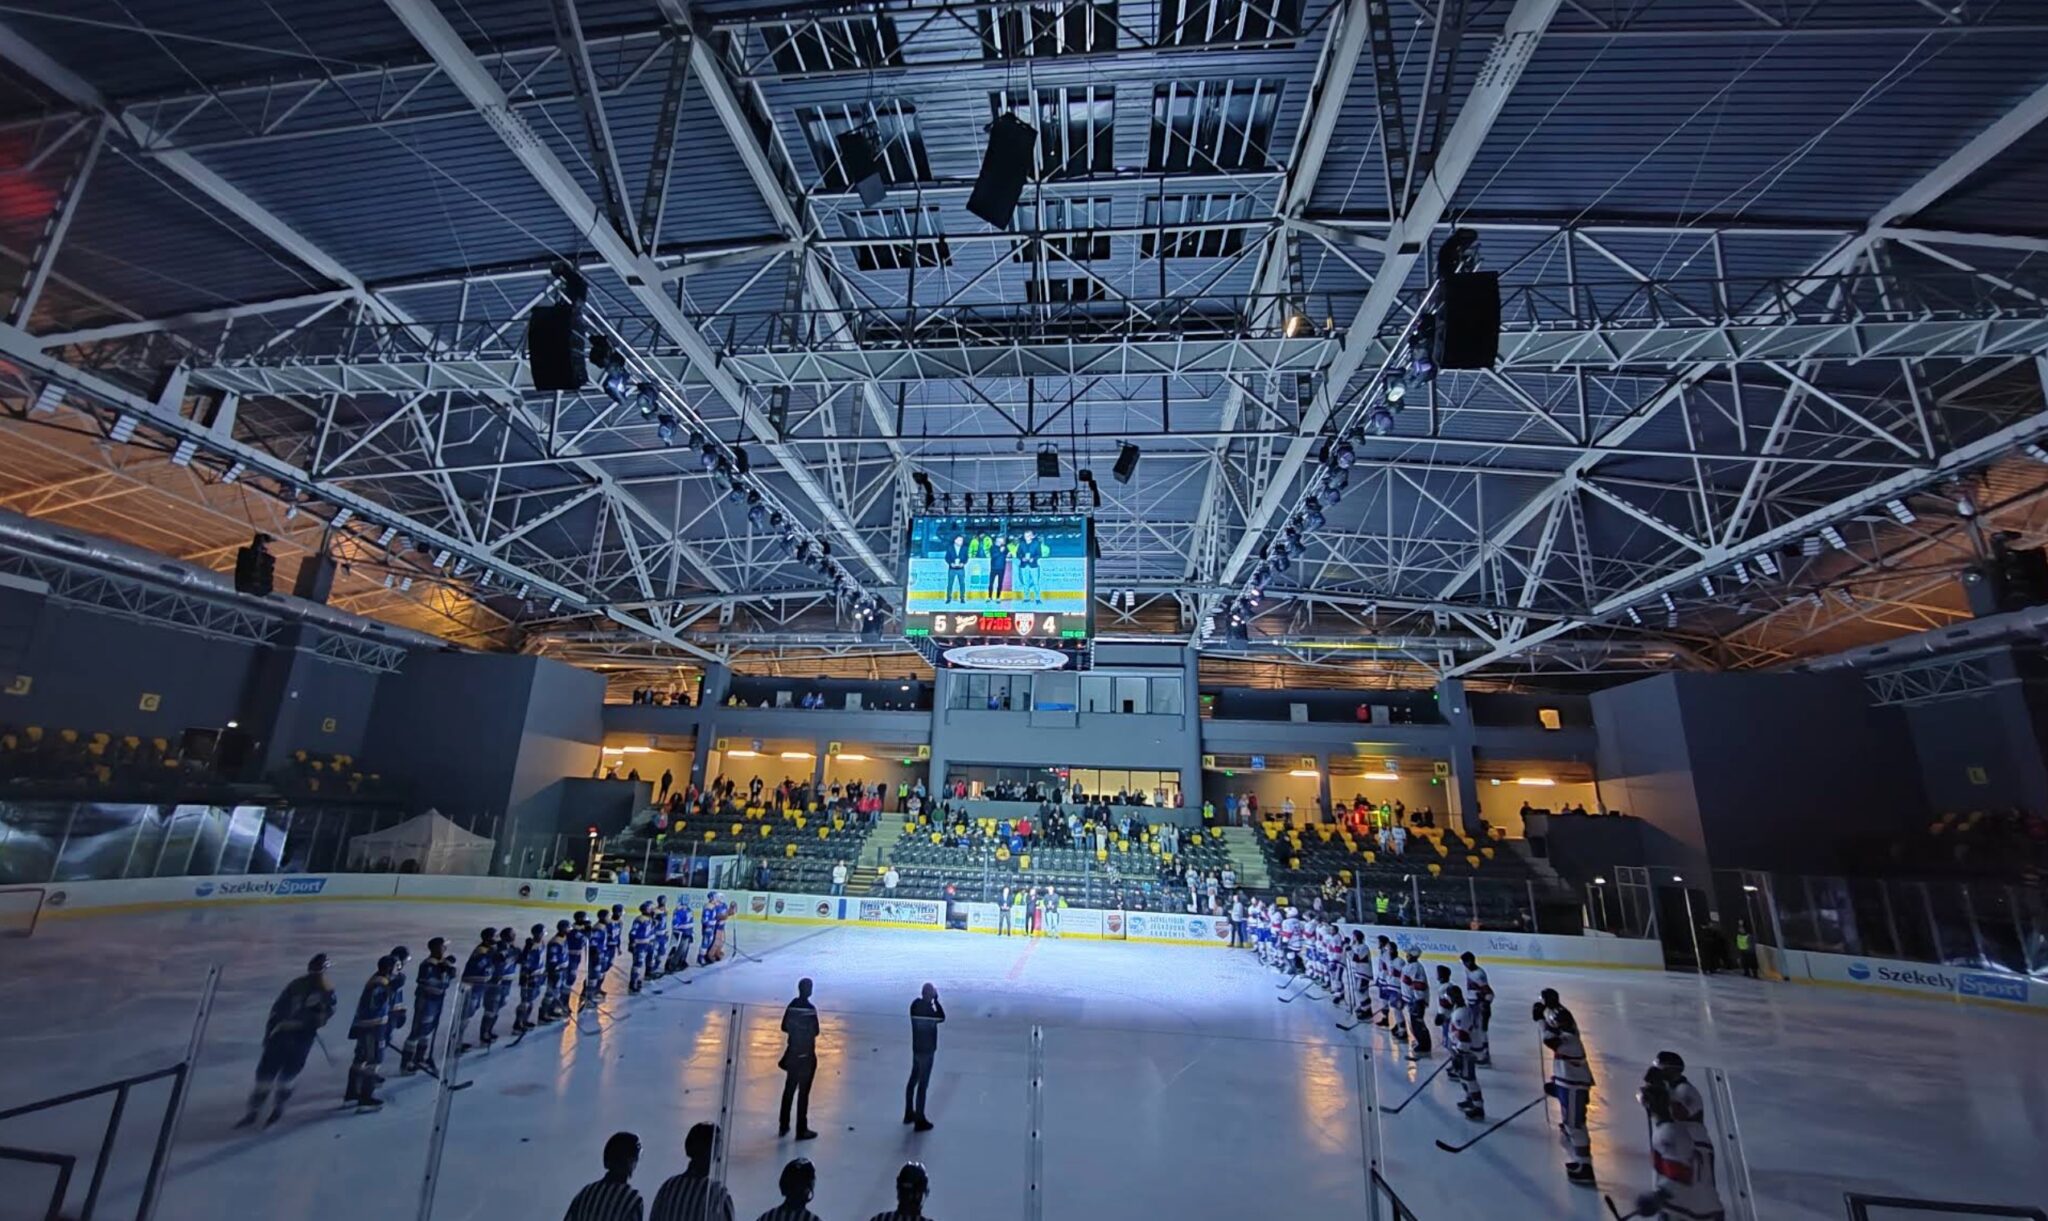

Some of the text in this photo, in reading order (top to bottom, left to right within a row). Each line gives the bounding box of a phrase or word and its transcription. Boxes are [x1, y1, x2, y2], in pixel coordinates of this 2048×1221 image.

[934, 615, 947, 632] 5
[1043, 616, 1056, 633] 4
[280, 880, 320, 893] Sport
[1963, 977, 2022, 996] Sport
